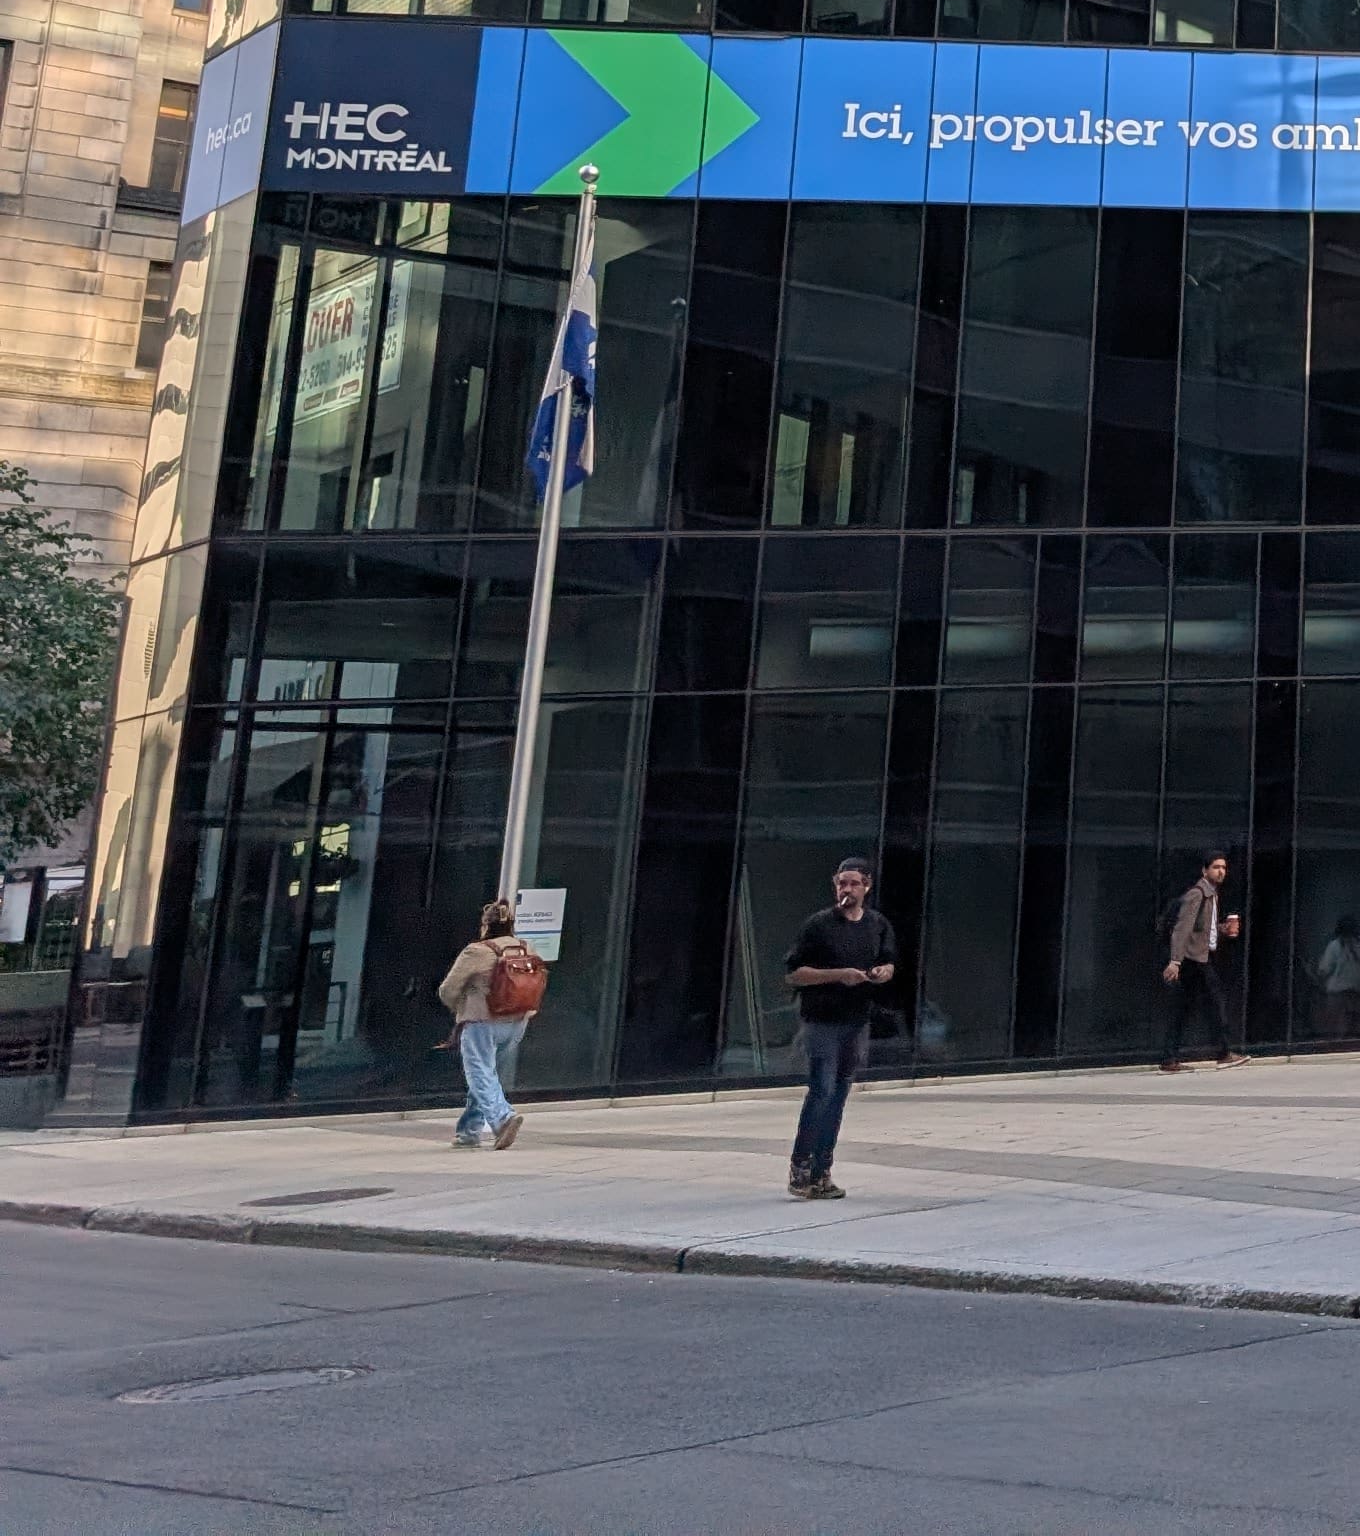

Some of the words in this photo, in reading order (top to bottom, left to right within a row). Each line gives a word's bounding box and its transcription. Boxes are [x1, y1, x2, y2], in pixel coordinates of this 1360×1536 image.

[205, 111, 252, 156] hec.ca
[284, 100, 409, 143] HEC
[842, 102, 914, 146] Ici,
[929, 110, 1164, 152] propulser
[1178, 120, 1258, 149] vos
[286, 143, 452, 173] MONTRÉAL
